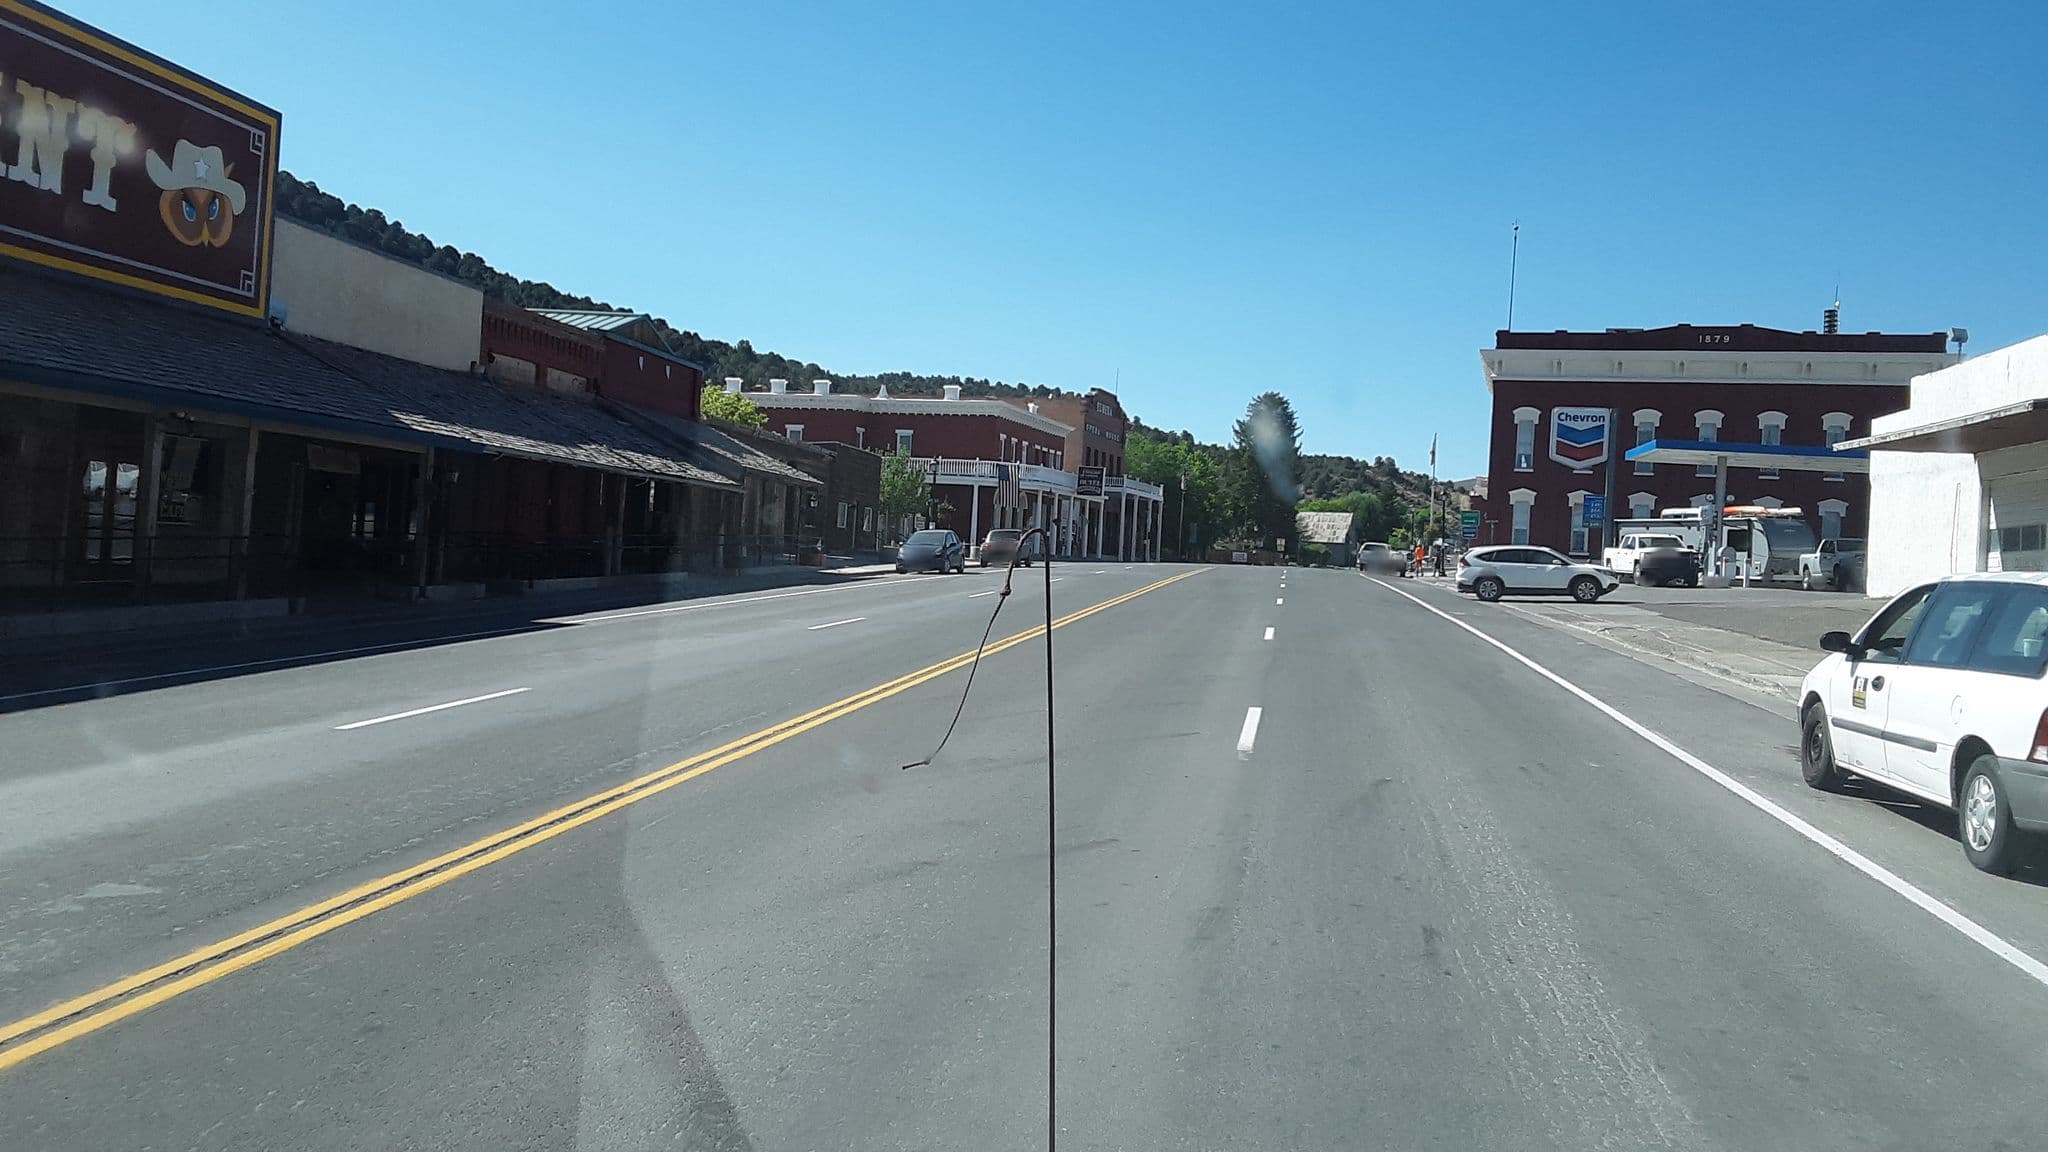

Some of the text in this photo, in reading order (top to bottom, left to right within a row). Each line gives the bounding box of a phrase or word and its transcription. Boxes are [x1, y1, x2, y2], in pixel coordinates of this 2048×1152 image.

[0, 72, 137, 212] NT
[1699, 334, 1730, 344] 1879
[1557, 411, 1605, 423] Chevron
